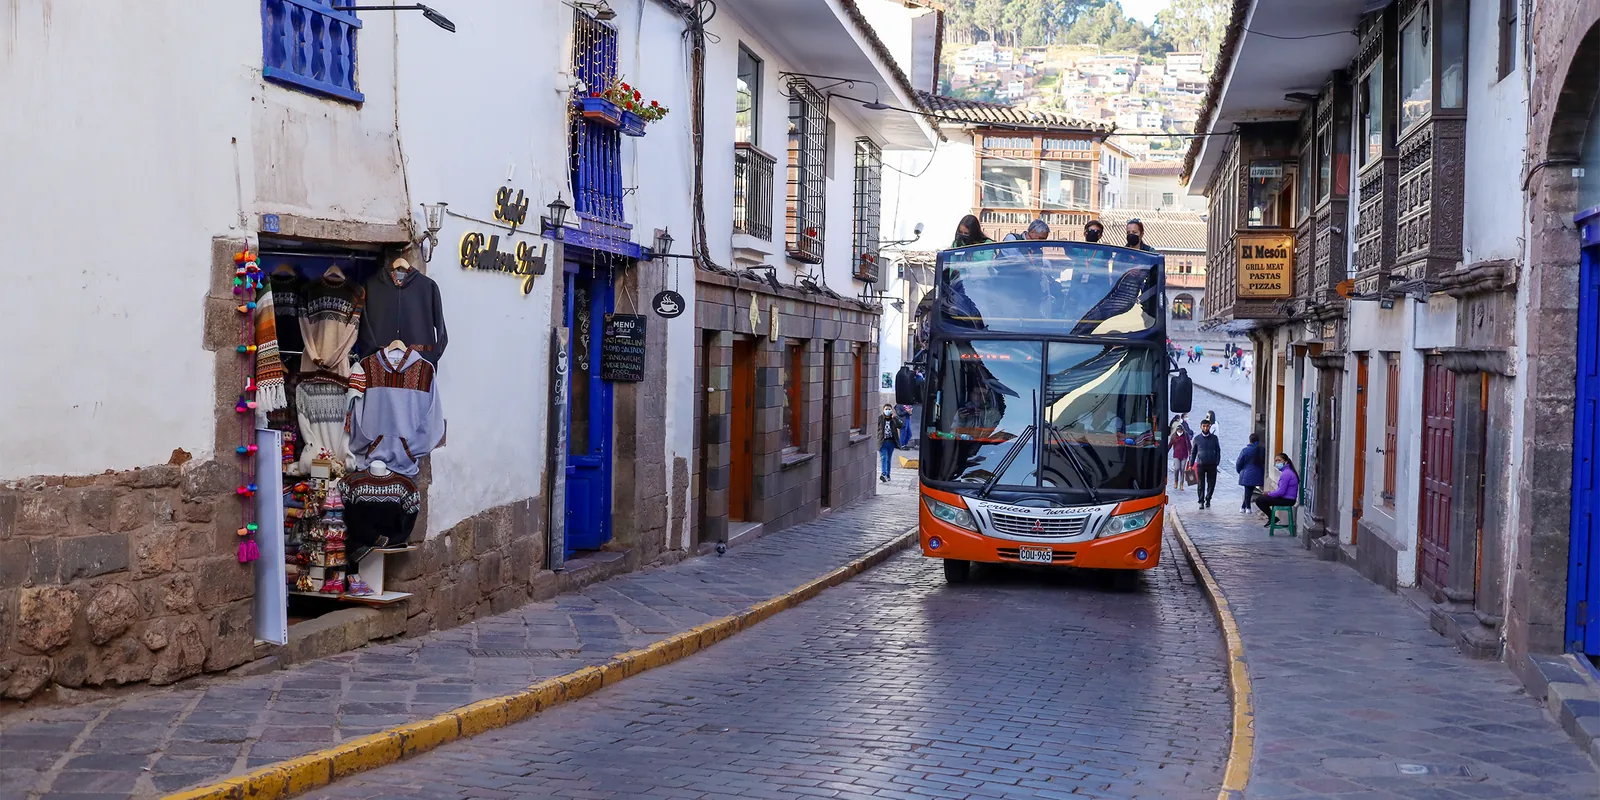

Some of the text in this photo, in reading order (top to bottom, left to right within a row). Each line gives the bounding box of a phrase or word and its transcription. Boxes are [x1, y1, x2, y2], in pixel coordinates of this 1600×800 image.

[1241, 244, 1287, 259] El Mesón
[1245, 263, 1284, 271] GRILL MEAT
[1249, 272, 1281, 280] PASTAS
[1249, 282, 1281, 290] PIZZAS
[613, 320, 635, 329] MENÚ
[977, 501, 1032, 514] Servicio
